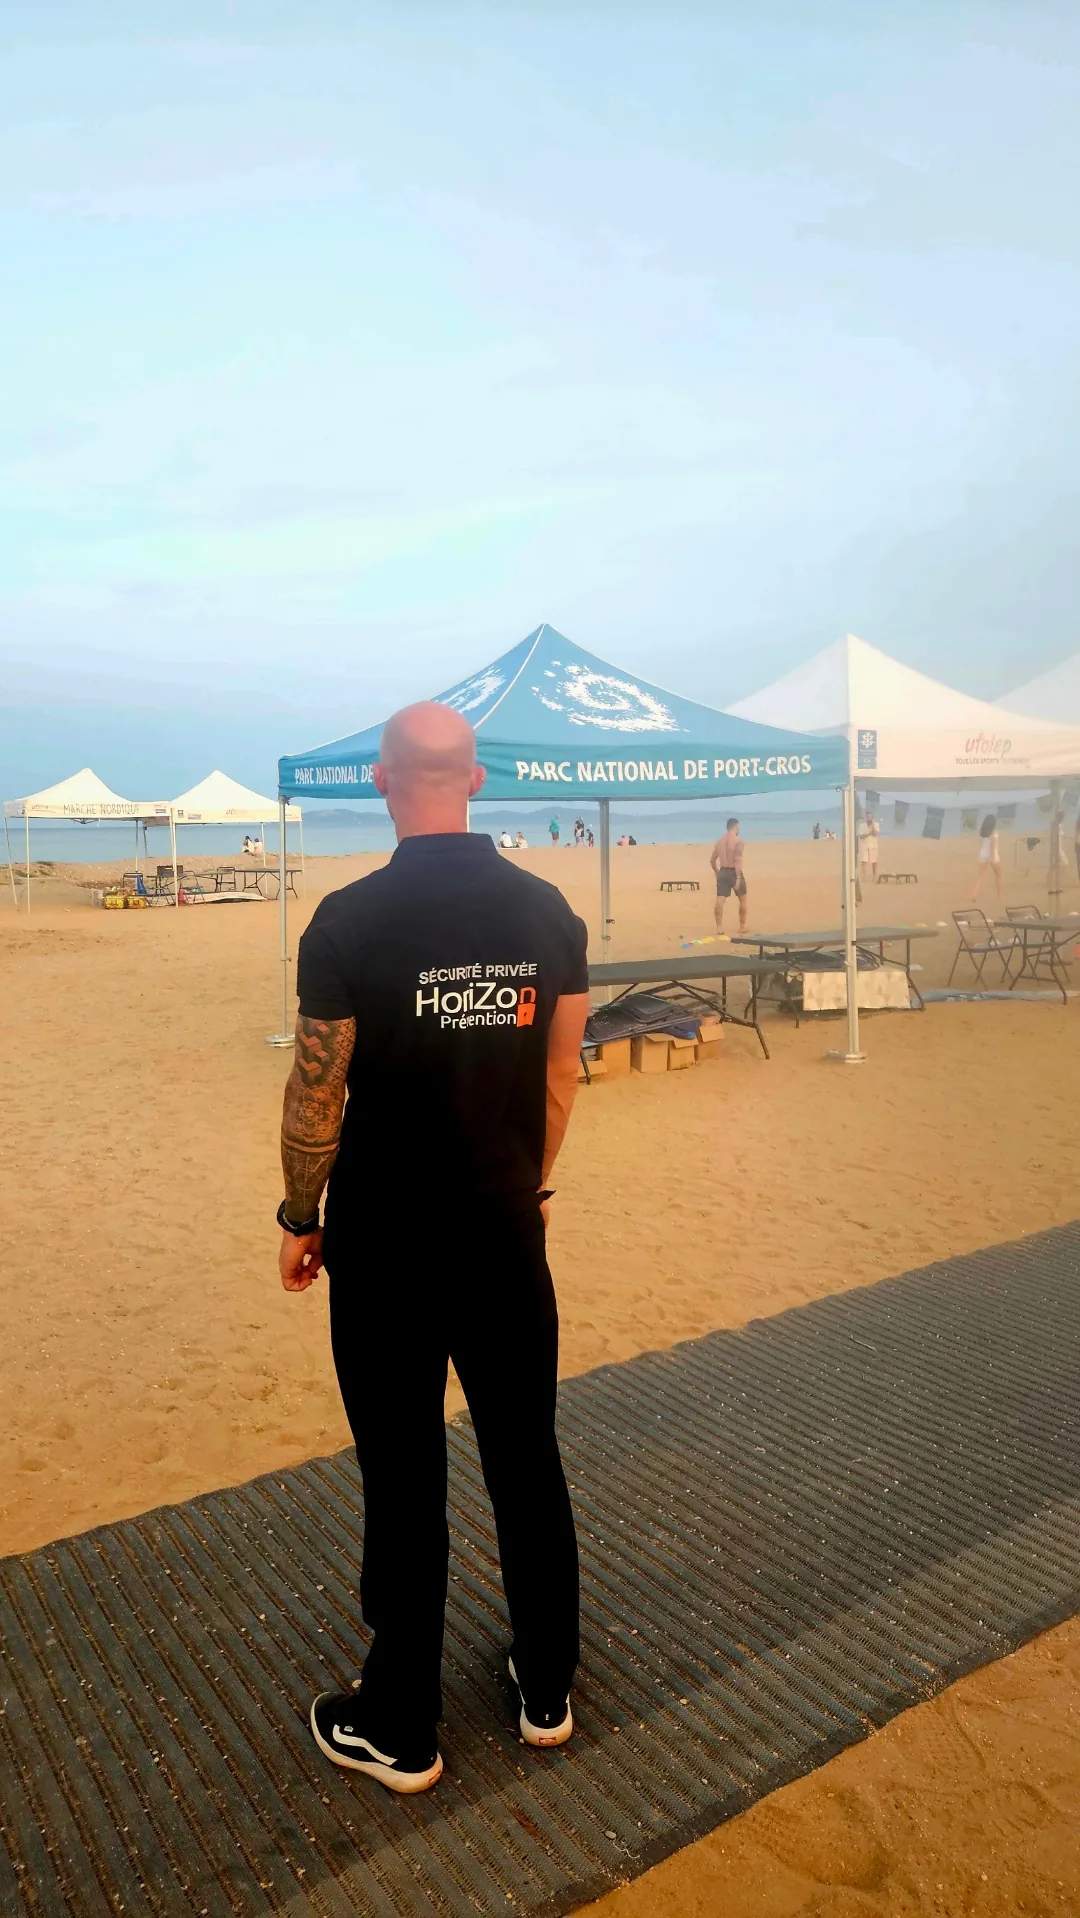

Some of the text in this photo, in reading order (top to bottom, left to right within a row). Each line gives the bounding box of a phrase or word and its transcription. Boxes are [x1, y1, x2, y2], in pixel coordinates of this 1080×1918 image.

[295, 768, 315, 785] PARC
[316, 765, 358, 785] NATIONAL
[516, 755, 812, 782] PARC NATIONAL DE PORT-CROS
[486, 961, 538, 978] PRIVÉE
